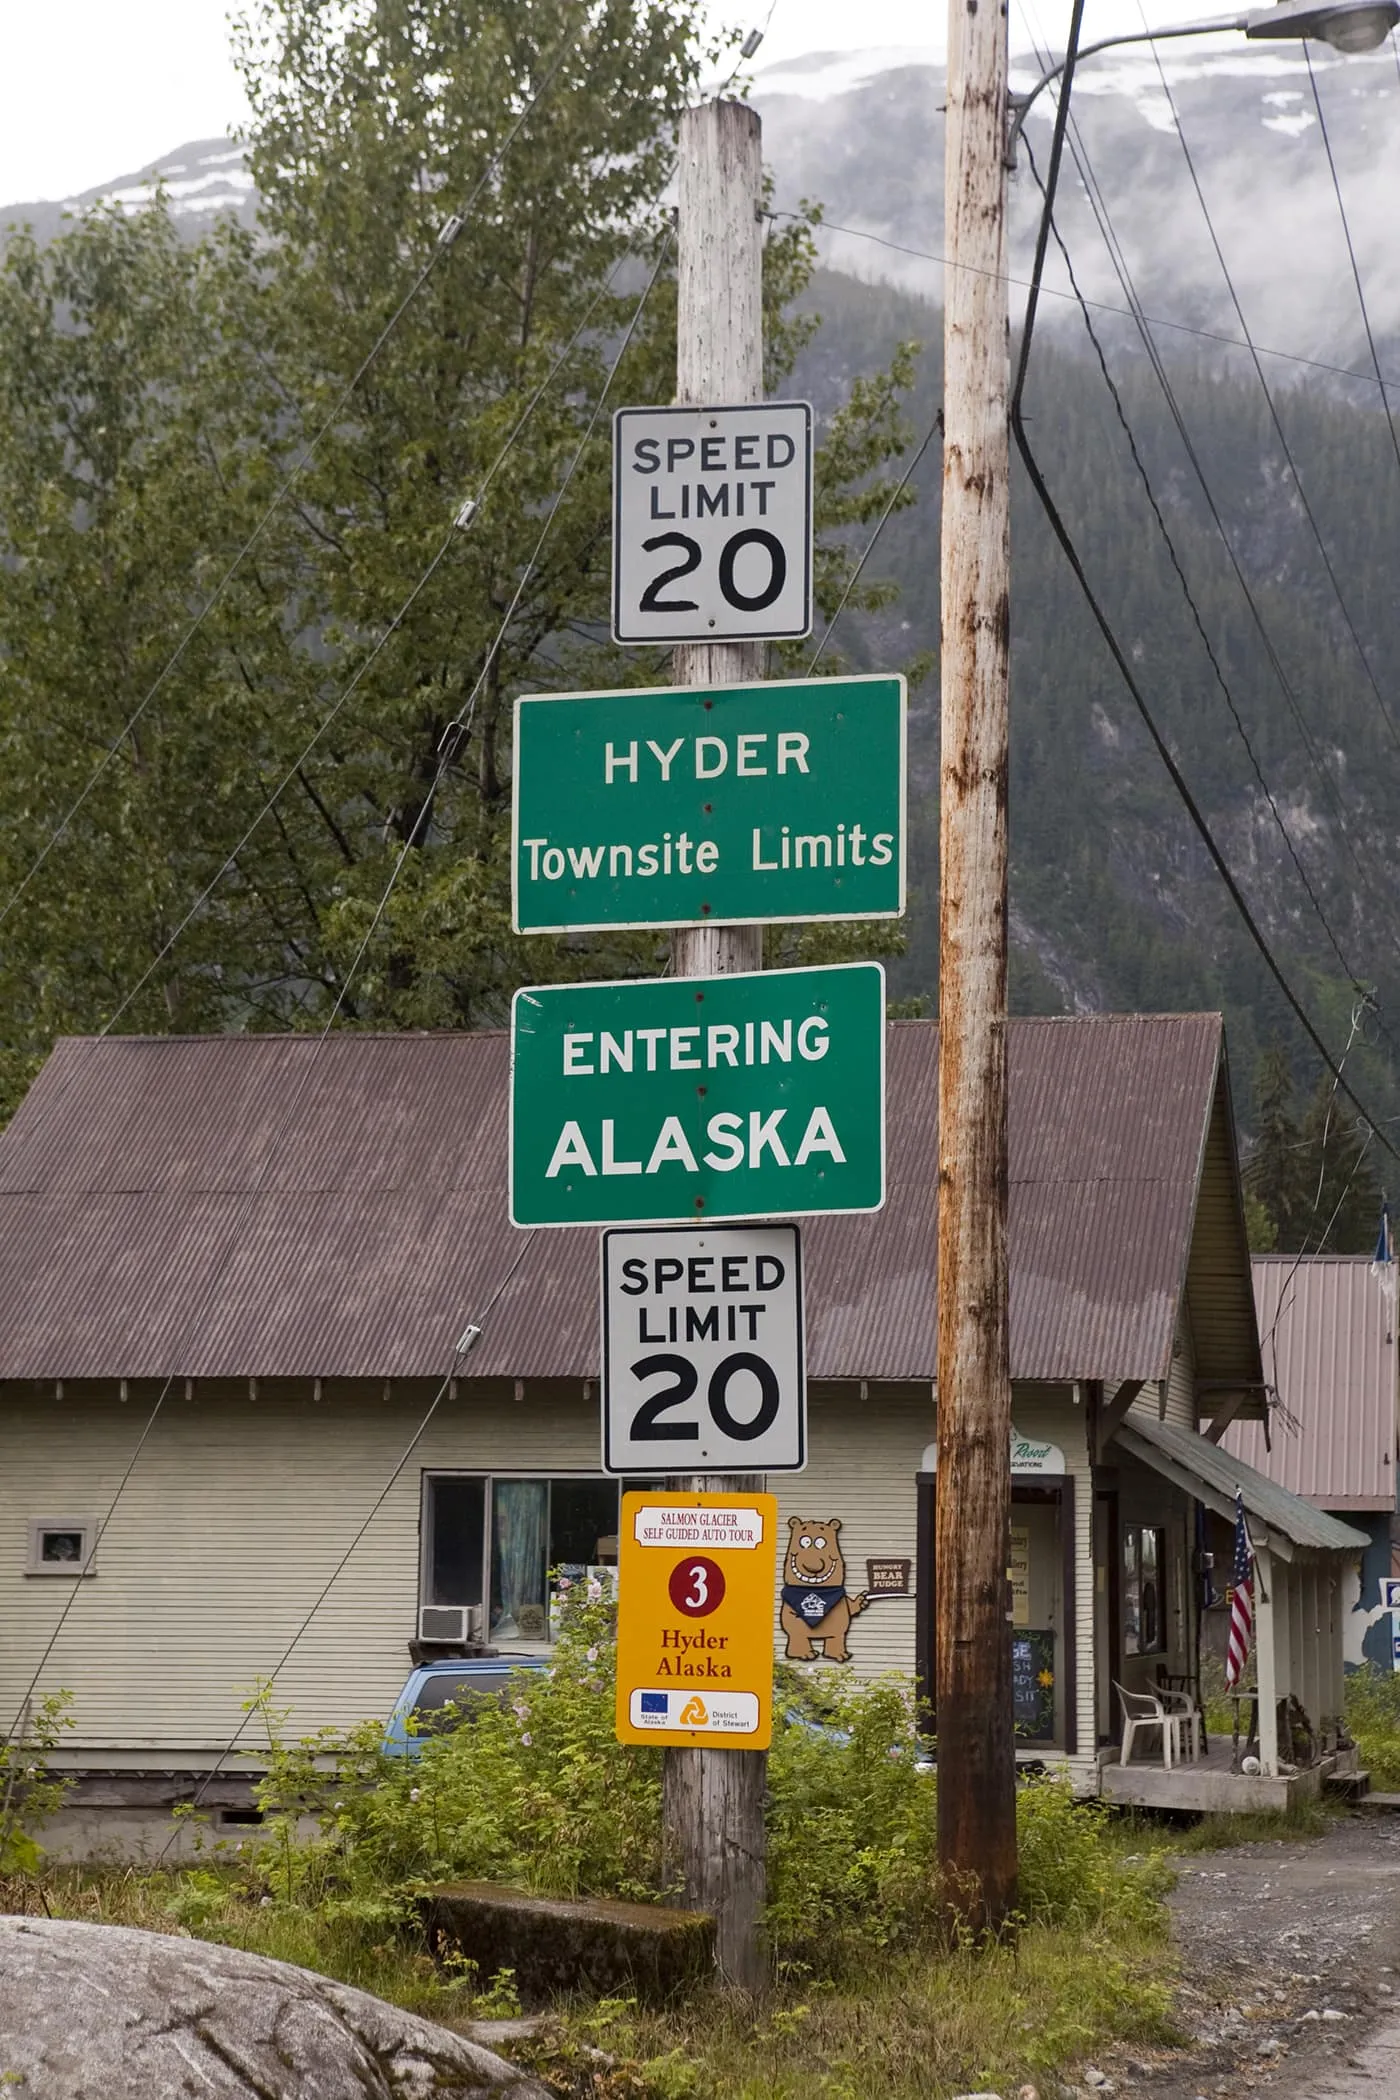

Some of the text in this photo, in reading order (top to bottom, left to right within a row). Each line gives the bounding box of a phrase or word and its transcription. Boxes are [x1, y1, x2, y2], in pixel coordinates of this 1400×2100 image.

[632, 433, 796, 475] SPEED
[650, 481, 776, 520] LIMIT
[639, 527, 787, 612] 20
[604, 732, 811, 785] HYDER
[522, 823, 894, 881] Townsite Limits
[563, 1015, 830, 1076] ENTERING
[544, 1106, 848, 1178] ALASKA
[619, 1255, 785, 1296] SPEED
[639, 1304, 766, 1344] LIMIT
[629, 1352, 780, 1442] 20
[643, 1528, 754, 1541] SELF GUIDED AUTO TOUR
[661, 1513, 738, 1526] SALMON GLACIER
[685, 1565, 708, 1608] 3
[873, 1571, 903, 1580] BEAR
[873, 1580, 904, 1588] FUDGE
[661, 1628, 729, 1655] Hyder
[656, 1655, 732, 1677] Alaska
[712, 1711, 738, 1719] District
